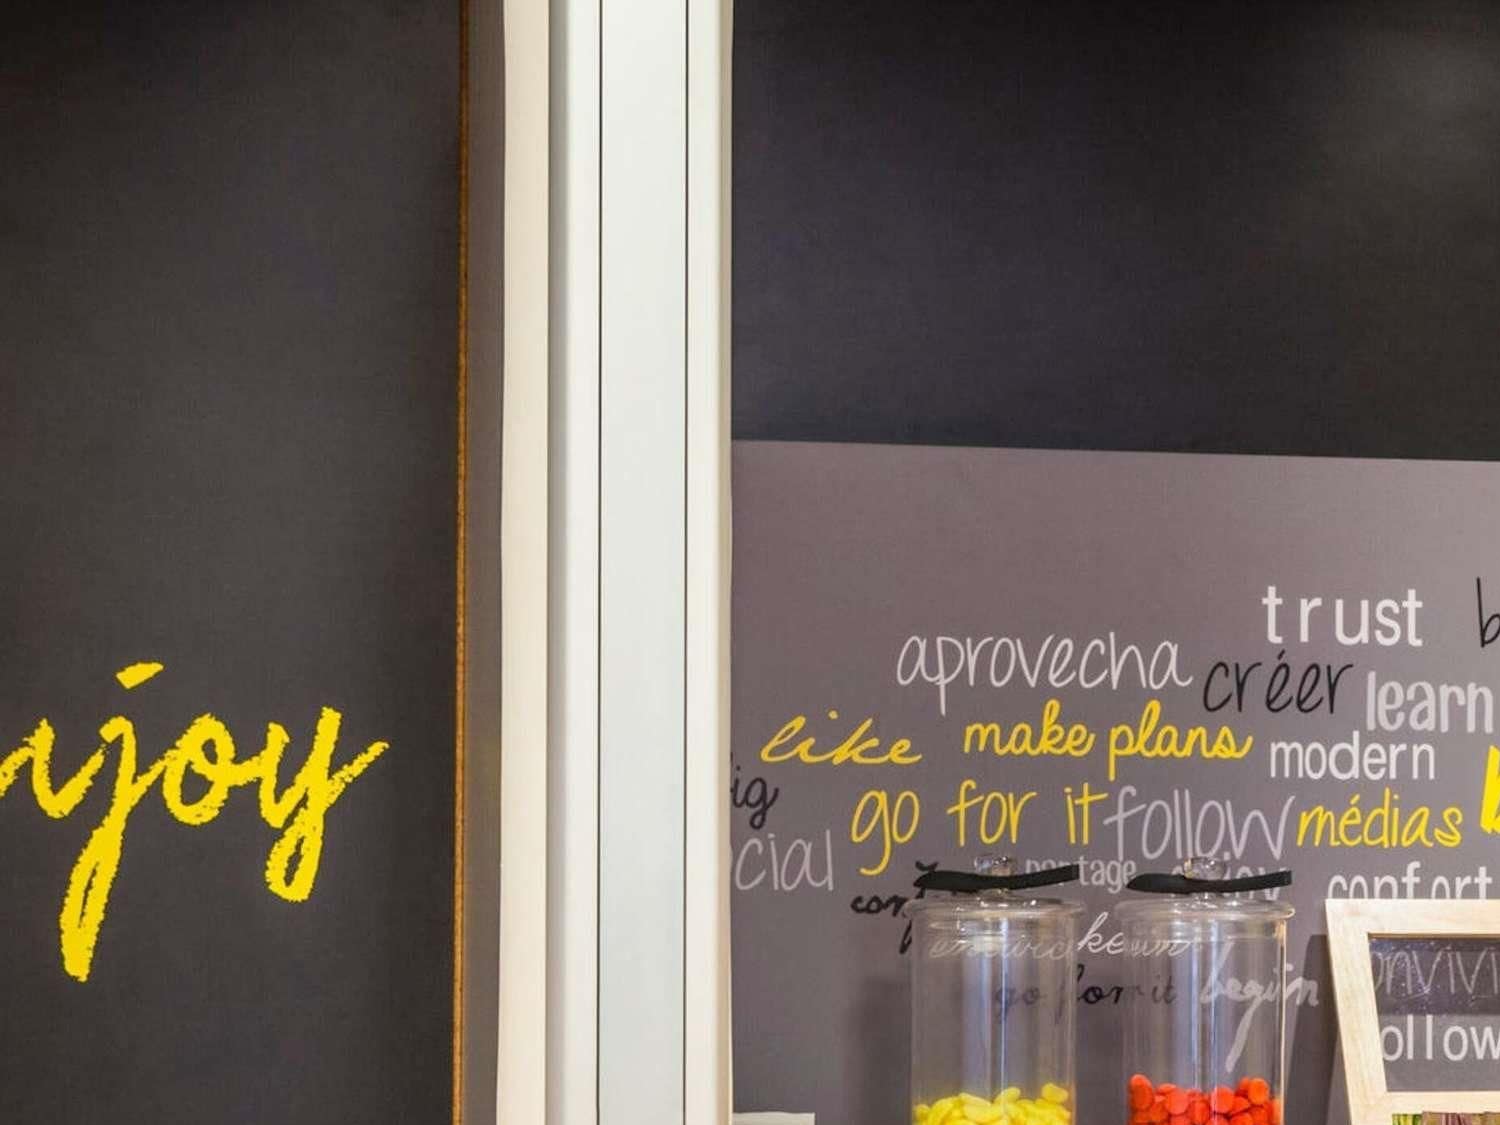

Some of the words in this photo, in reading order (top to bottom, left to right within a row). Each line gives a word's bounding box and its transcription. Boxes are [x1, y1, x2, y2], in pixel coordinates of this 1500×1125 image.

[1263, 586, 1423, 647] trust
[897, 631, 1193, 715] aprovecha
[1203, 650, 1352, 714] créer
[1366, 671, 1494, 733] learn
[761, 710, 922, 766] like
[964, 698, 1095, 758] make
[1109, 699, 1253, 781] plans
[1270, 731, 1435, 780] modern
[0, 662, 390, 982] njoy
[730, 754, 779, 829] ig
[1104, 785, 1295, 861] follow
[1297, 788, 1462, 847] médias
[851, 788, 920, 876] go
[947, 779, 1037, 847] for
[1063, 782, 1109, 845] it
[732, 829, 833, 891] cial
